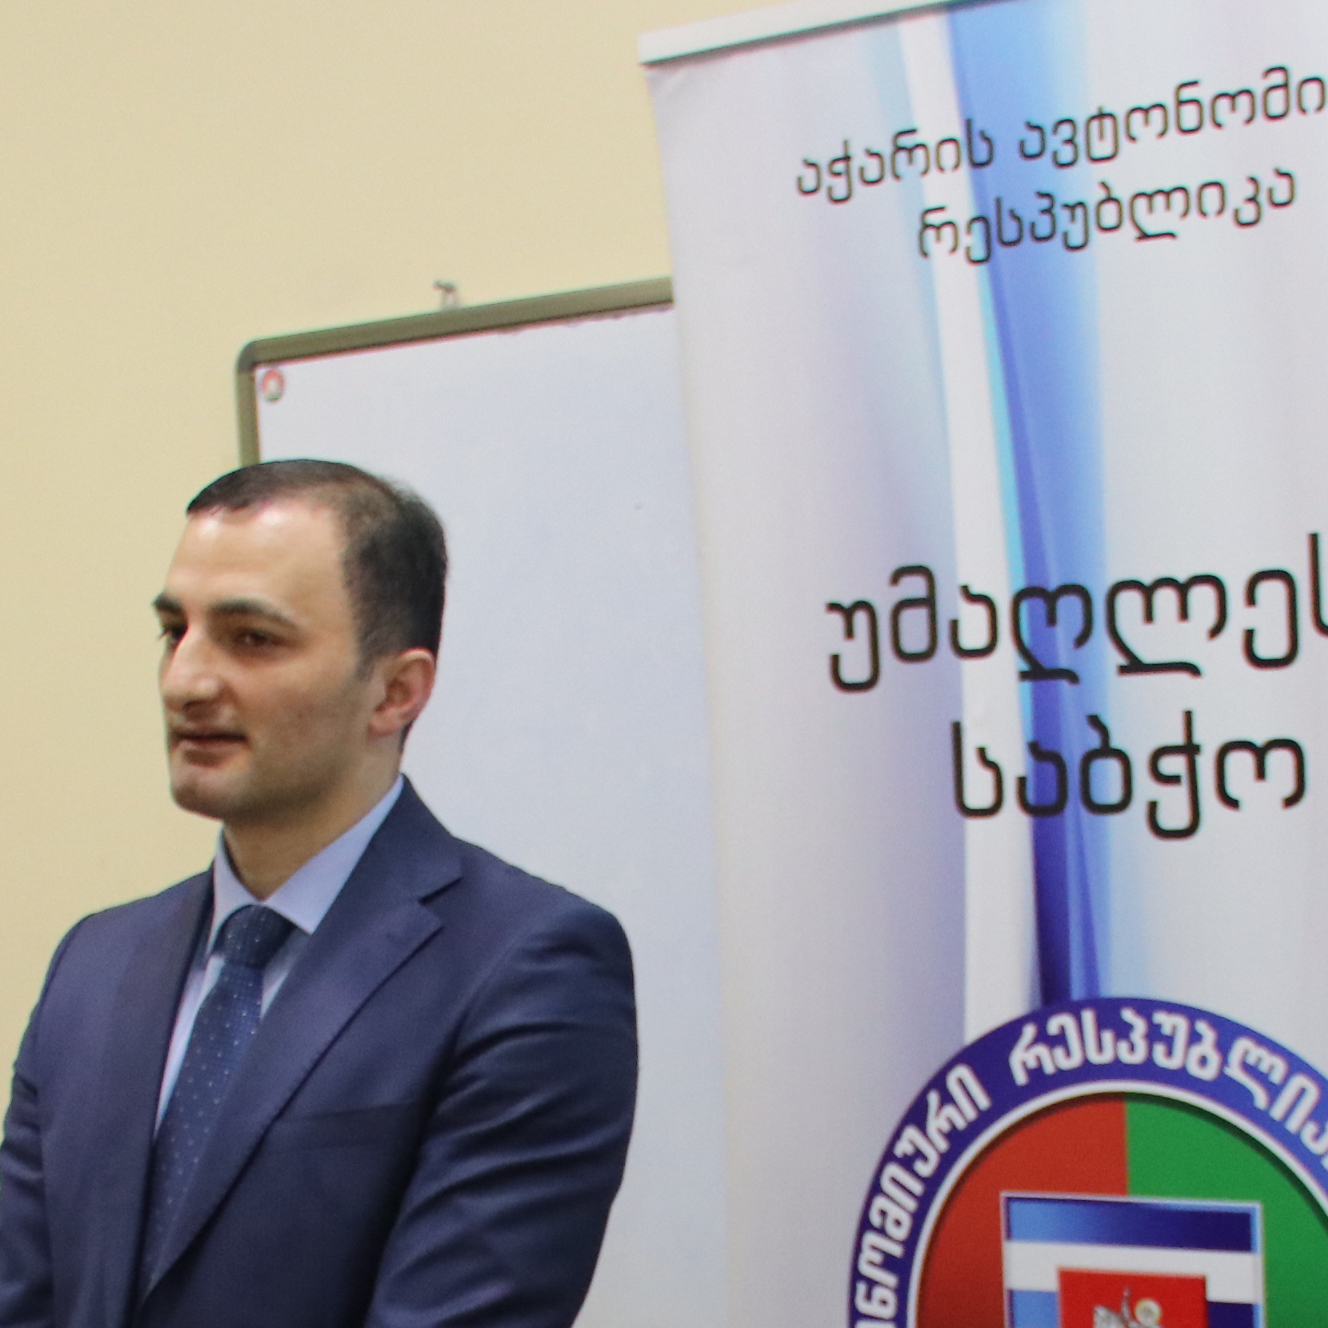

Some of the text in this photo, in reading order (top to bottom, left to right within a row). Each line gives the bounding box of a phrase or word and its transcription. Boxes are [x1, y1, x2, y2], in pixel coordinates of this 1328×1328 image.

[797, 119, 994, 204] აჭარის
[918, 168, 1296, 265] რესპუბლიკა
[950, 709, 1307, 840] საბჭო
